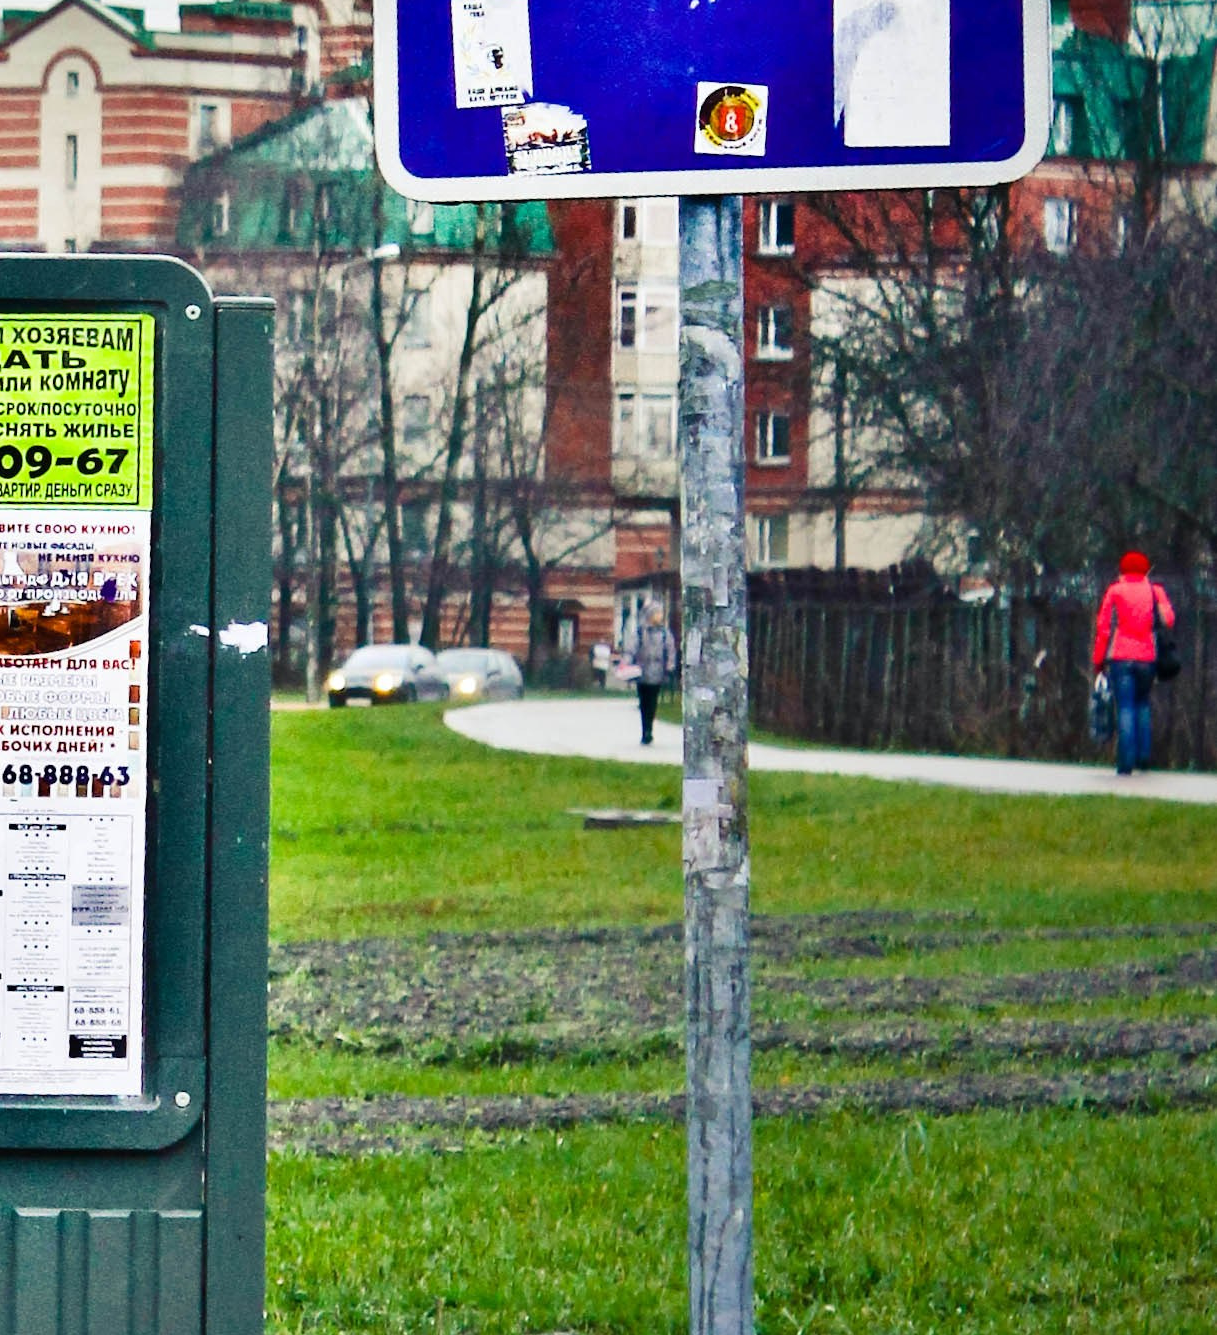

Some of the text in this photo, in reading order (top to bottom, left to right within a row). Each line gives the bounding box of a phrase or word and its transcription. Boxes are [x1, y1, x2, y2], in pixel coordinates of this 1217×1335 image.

[12, 327, 133, 352] ХОЗЯЕВАМ
[40, 368, 130, 398] комнату
[64, 423, 134, 438] ЖИЛЬЕ
[45, 482, 92, 500] ДЕНЬГИ
[95, 483, 133, 497] СРАЗУ
[35, 524, 77, 534] СВОЮ
[82, 525, 135, 535] КУХНЮ!
[38, 554, 140, 563] НЕ МЕНЯЯ КУХНЮ
[66, 659, 97, 670] ДЛЯ
[103, 658, 135, 670] ВАС!
[21, 672, 98, 687] РАЗМЕРЫ
[44, 689, 111, 704] ФОРМЫ
[6, 706, 125, 722] ЛЮБЫЕ ЦВЕТА
[10, 725, 115, 736] ИСПОЛНЕНИЯ
[57, 739, 104, 753] ДНЕЙ!
[2, 764, 130, 786] 68-888-63
